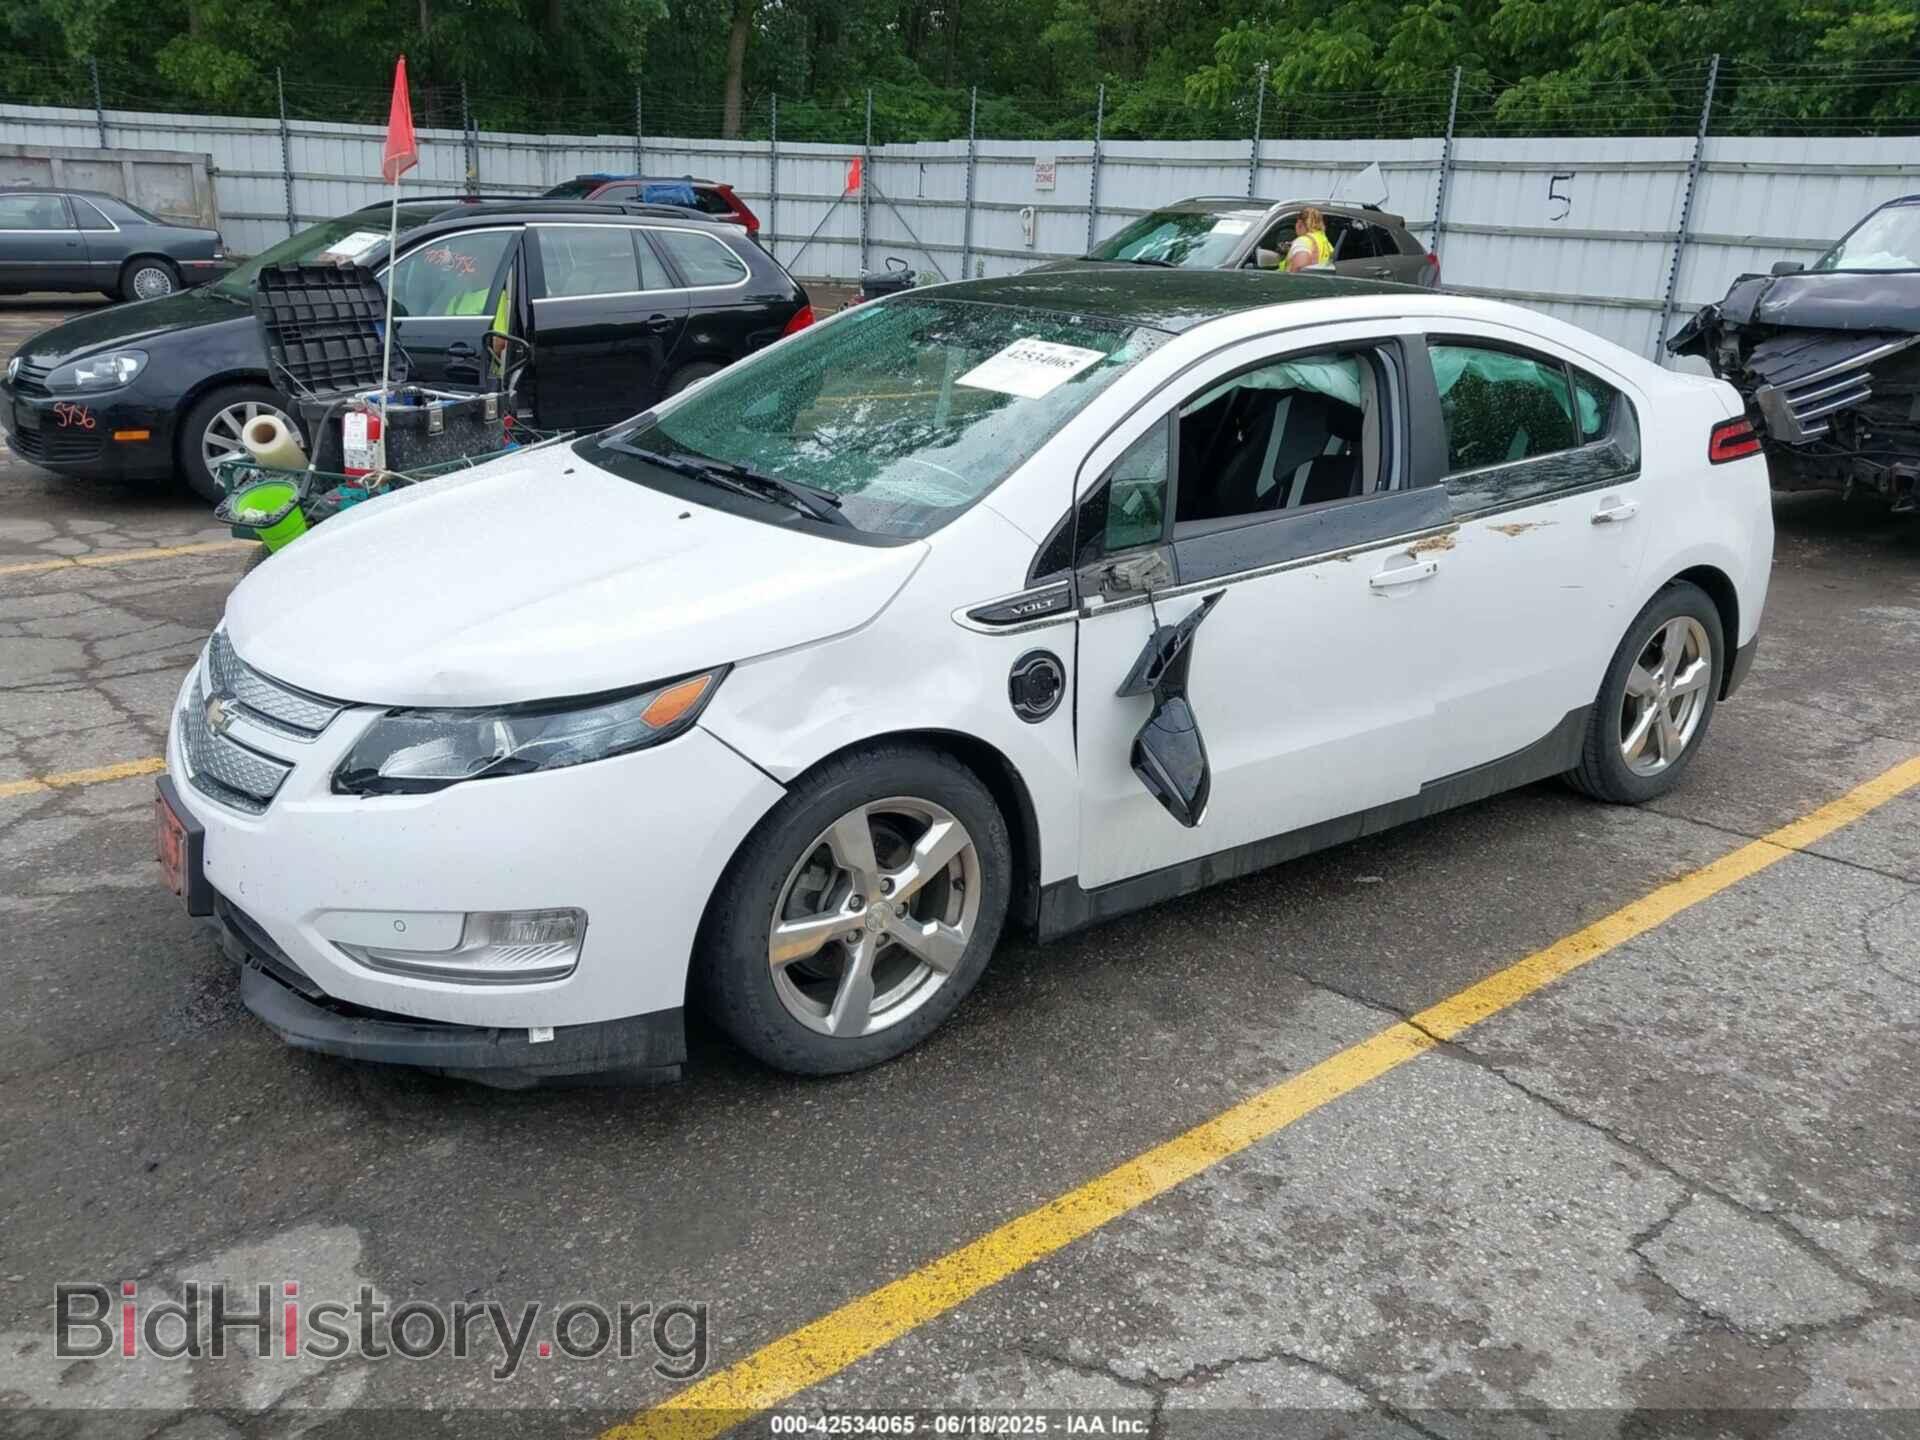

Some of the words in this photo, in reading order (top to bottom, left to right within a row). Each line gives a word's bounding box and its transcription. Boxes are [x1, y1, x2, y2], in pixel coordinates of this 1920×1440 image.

[1035, 163, 1054, 172] DROP
[1035, 173, 1055, 183] ZONE
[1548, 171, 1576, 221] 5
[1010, 599, 1055, 615] VOLT
